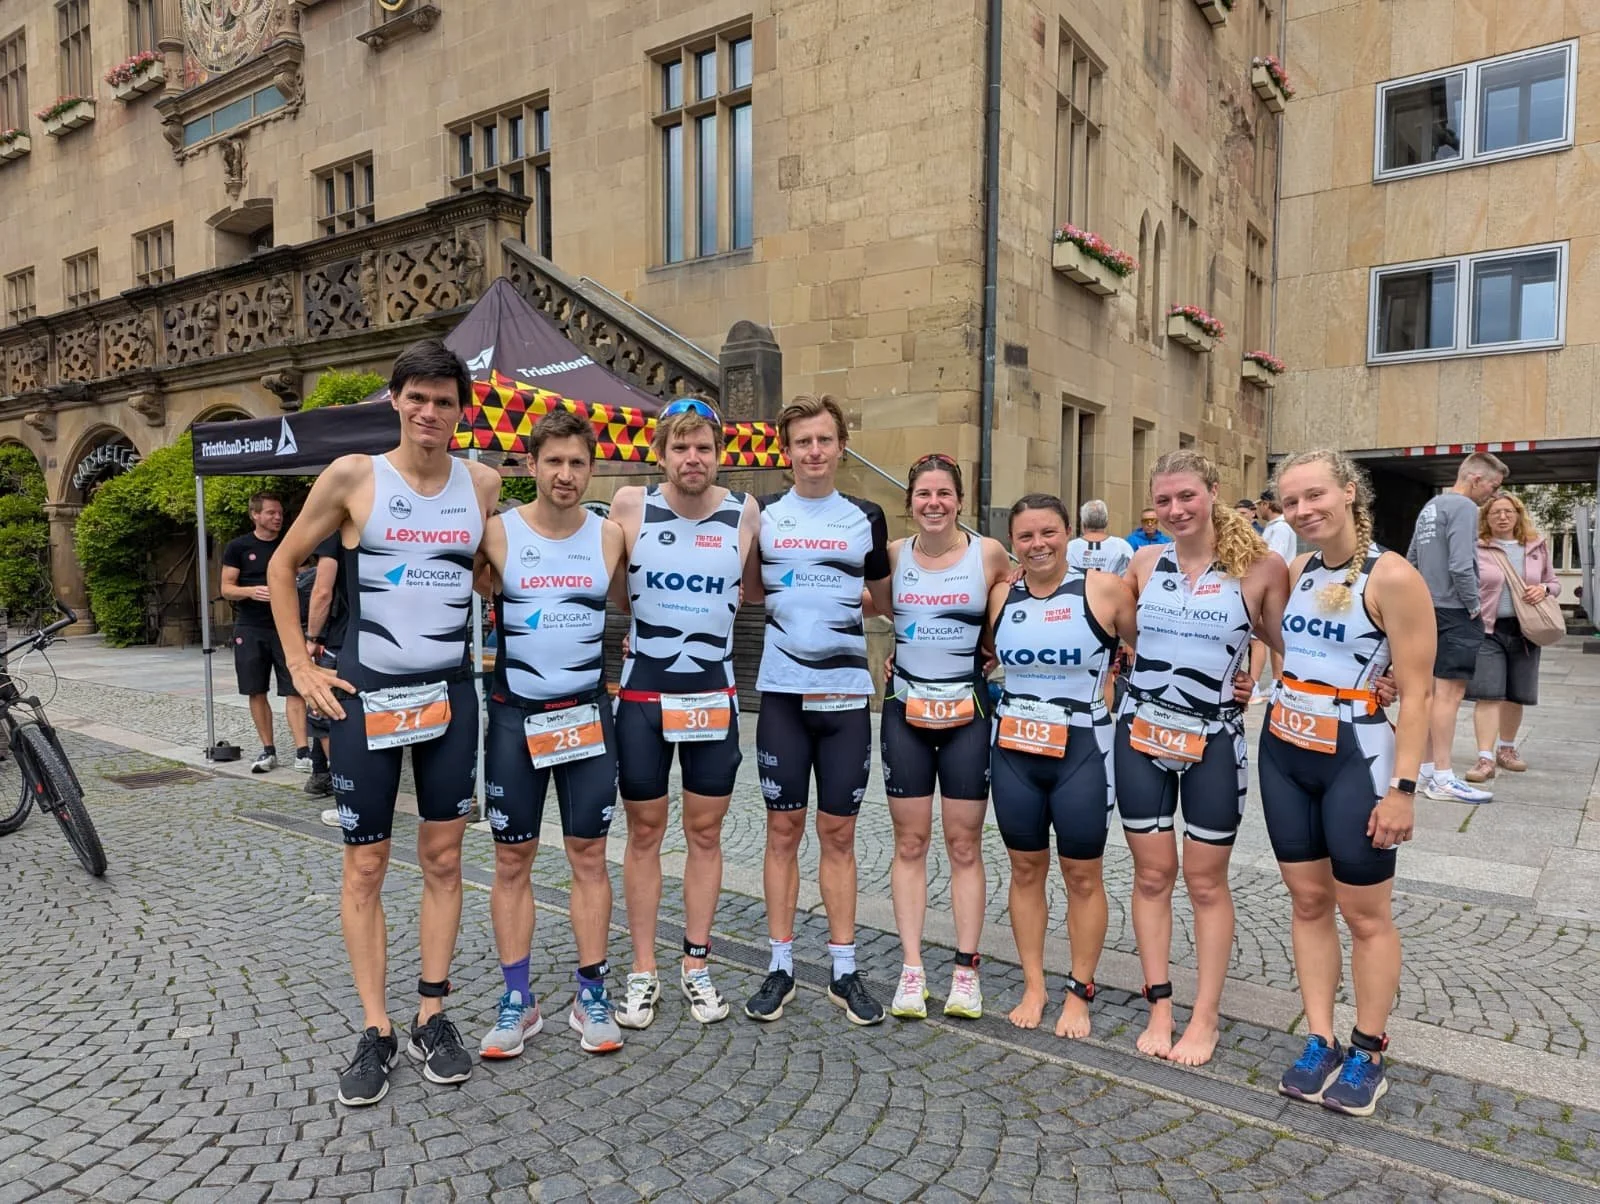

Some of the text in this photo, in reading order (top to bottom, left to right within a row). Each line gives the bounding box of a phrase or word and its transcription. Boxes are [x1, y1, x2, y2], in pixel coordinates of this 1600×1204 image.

[202, 437, 273, 457] TriathlonD-Events
[72, 444, 136, 489] RATSKELLE
[385, 527, 471, 544] Lexware
[774, 538, 848, 551] Lexware
[406, 568, 463, 581] RÜCKGRAT
[521, 575, 593, 589] Lexware
[646, 571, 725, 595] KOCH
[795, 573, 842, 583] RÜCKGRAT
[897, 592, 970, 606] Lexware
[543, 611, 592, 622] RÜCKGRAT
[1192, 609, 1229, 623] KOCH
[1281, 614, 1346, 643] KOCH
[1000, 648, 1082, 666] KOCH
[921, 701, 960, 719] 101
[393, 707, 423, 732] 27
[685, 710, 709, 729] 30
[1278, 707, 1317, 737] 102
[1013, 719, 1051, 742] 103
[1146, 725, 1188, 752] 104
[552, 728, 580, 752] 28
